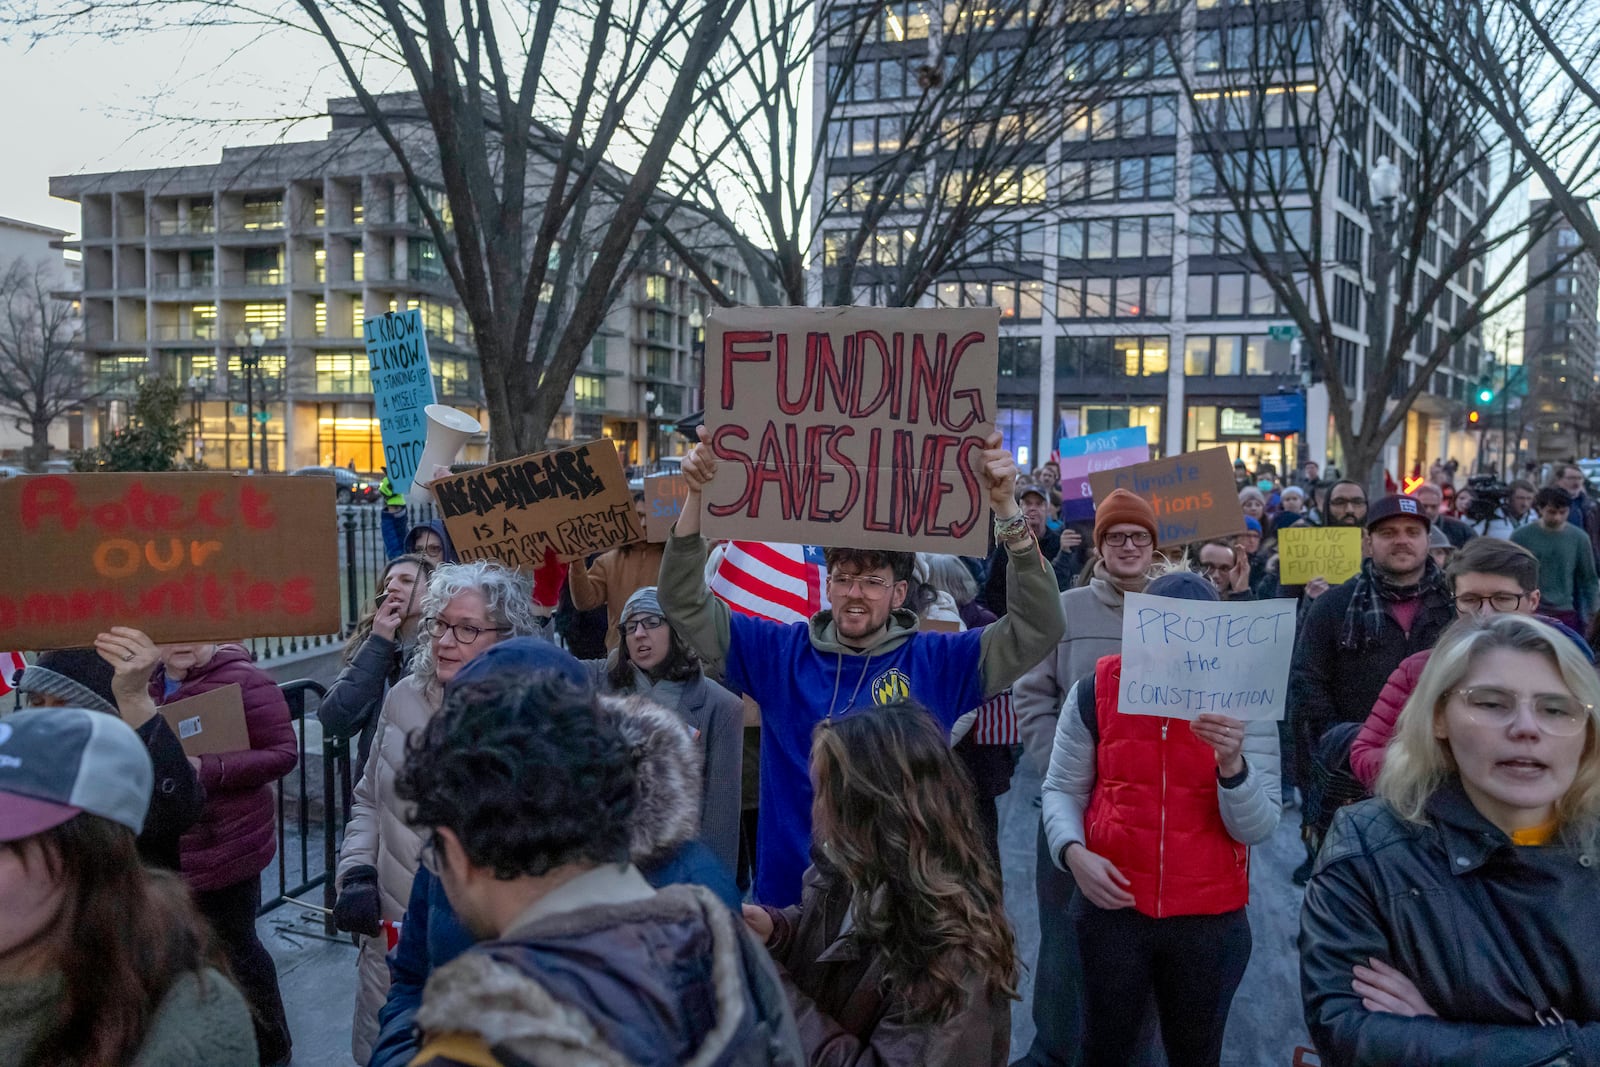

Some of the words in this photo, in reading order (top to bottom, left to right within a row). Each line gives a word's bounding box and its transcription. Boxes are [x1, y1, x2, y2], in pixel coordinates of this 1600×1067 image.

[365, 320, 376, 343] I
[369, 348, 380, 371] I
[383, 370, 416, 390] STANDING
[721, 330, 986, 432] FUNDING
[413, 413, 420, 427] A
[386, 439, 425, 480] BITC
[435, 445, 606, 519] HEALTHCARE
[707, 420, 861, 523] SAVES
[863, 427, 985, 539] LIVES
[1115, 462, 1199, 493] Climate
[472, 524, 495, 541] IS
[502, 517, 519, 537] A
[555, 501, 640, 556] RIGHT
[1286, 544, 1309, 559] AID
[1136, 608, 1292, 648] PROTECT
[1184, 651, 1222, 672] the
[1127, 680, 1276, 711] CONSTITUTION
